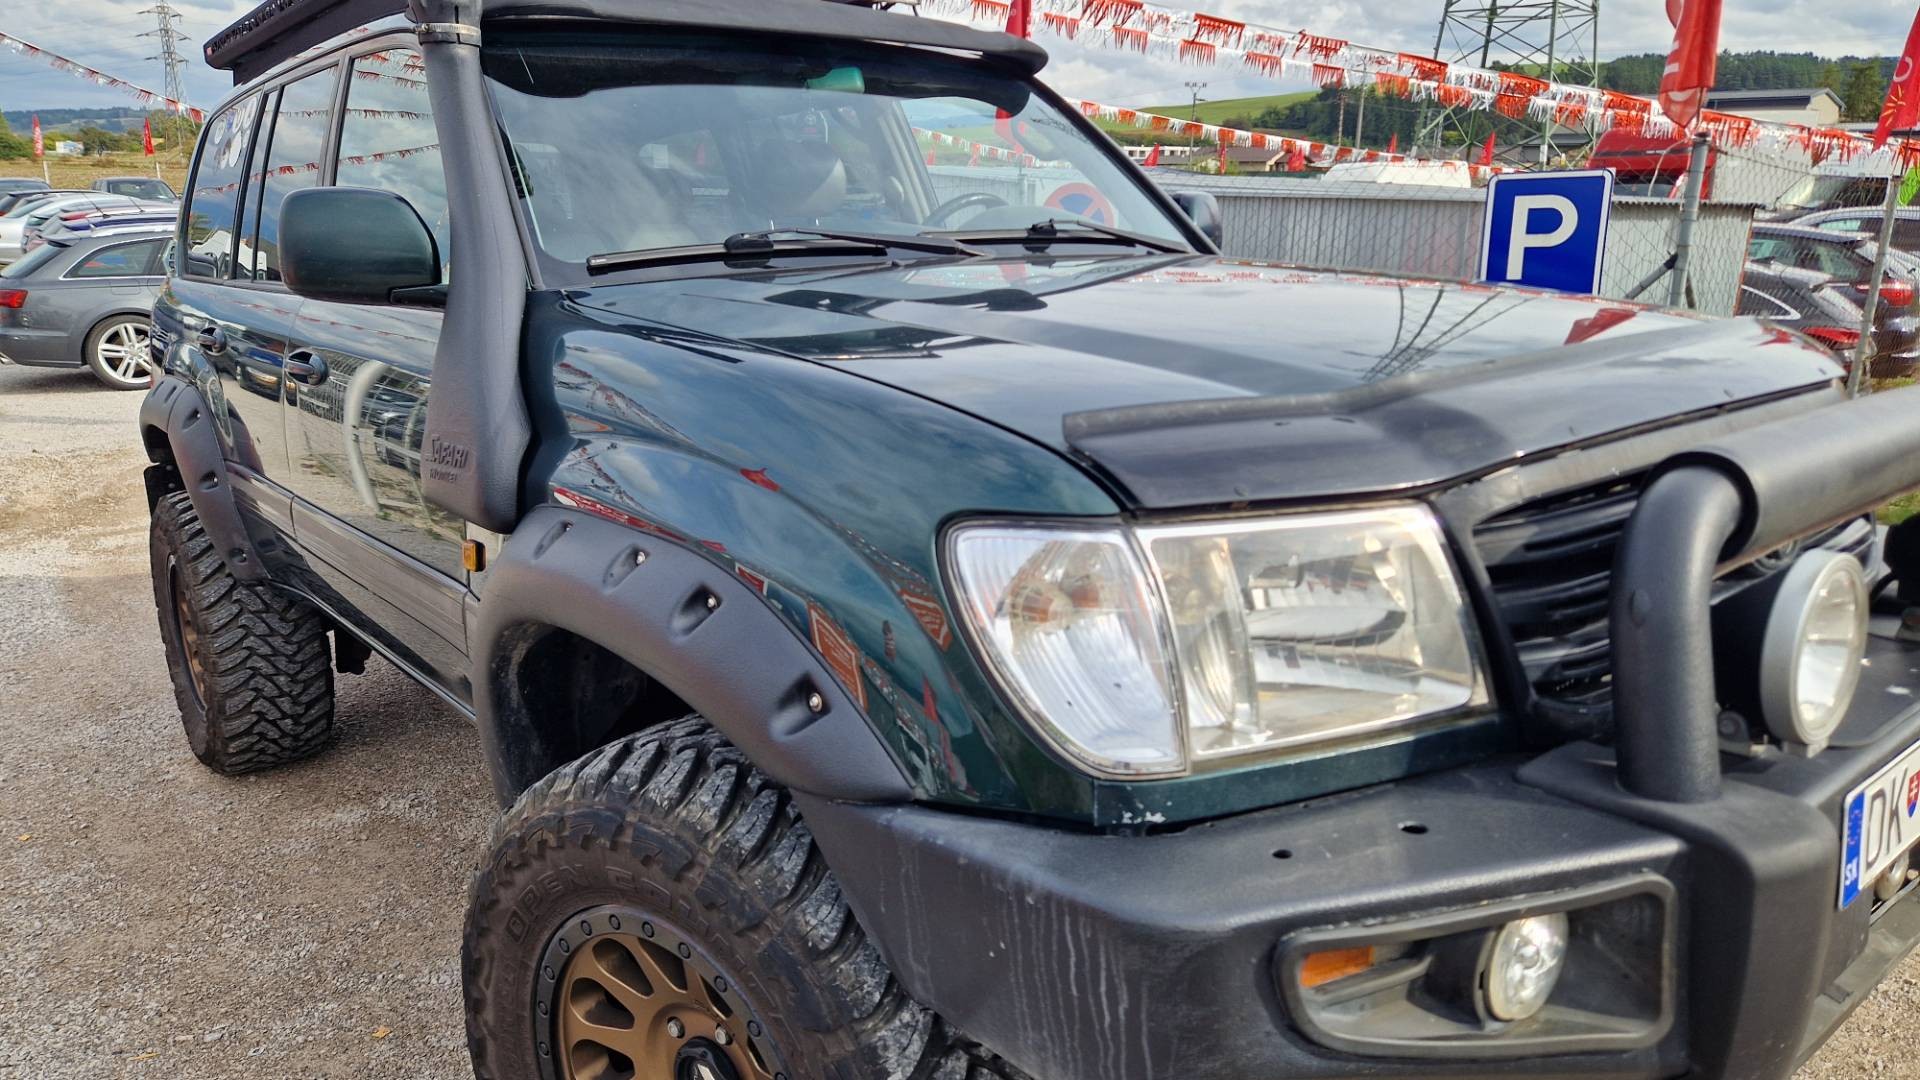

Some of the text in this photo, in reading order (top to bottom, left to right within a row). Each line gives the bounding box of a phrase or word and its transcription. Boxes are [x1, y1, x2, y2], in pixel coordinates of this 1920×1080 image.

[1506, 194, 1578, 281] P
[1865, 765, 1909, 872] DK
[504, 864, 589, 945] OPEN
[1844, 858, 1858, 886] SK
